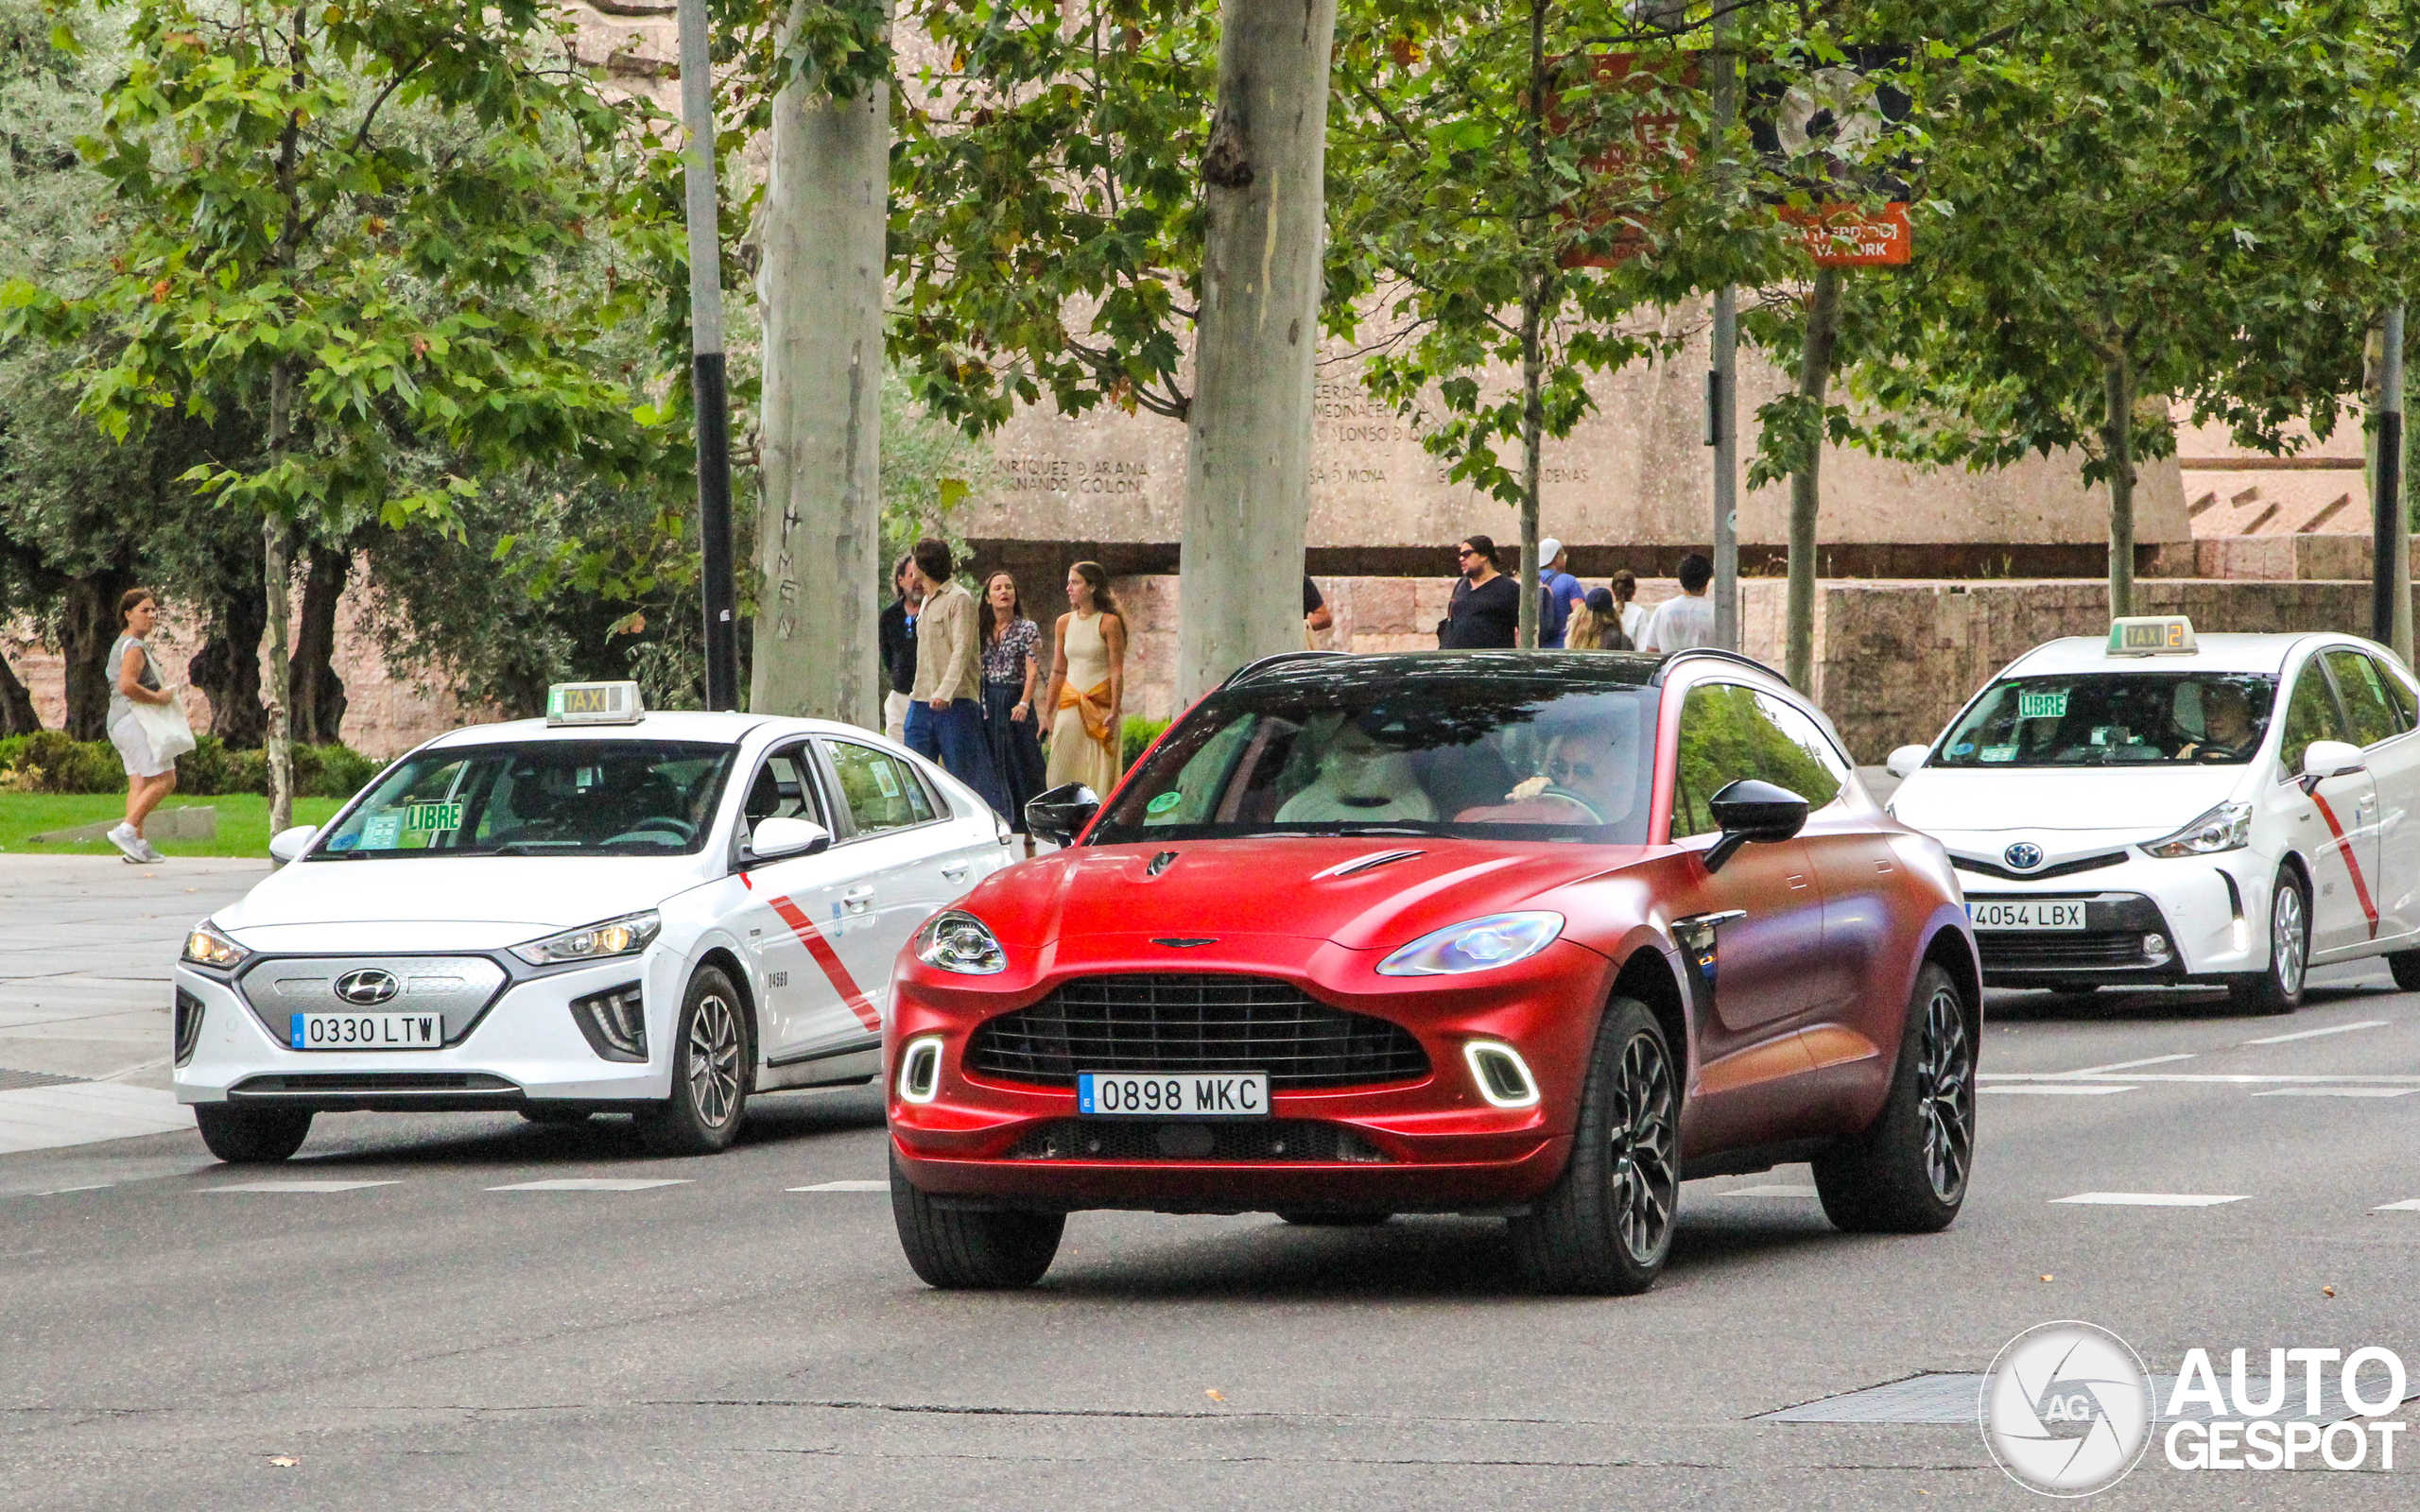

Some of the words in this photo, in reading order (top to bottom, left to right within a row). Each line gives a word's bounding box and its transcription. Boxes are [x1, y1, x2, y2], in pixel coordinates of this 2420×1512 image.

[2128, 627, 2164, 645] TAXI
[2169, 625, 2183, 645] 2
[564, 690, 606, 712] TAXI
[2021, 696, 2065, 716] LIBRE
[409, 804, 460, 830] LIBRE
[1976, 905, 2030, 925] 4054
[2038, 905, 2080, 925] LBX
[310, 1019, 374, 1042] 0330
[384, 1018, 433, 1042] LTW
[1102, 1080, 1183, 1110] 0898
[1195, 1079, 1257, 1110] MKC
